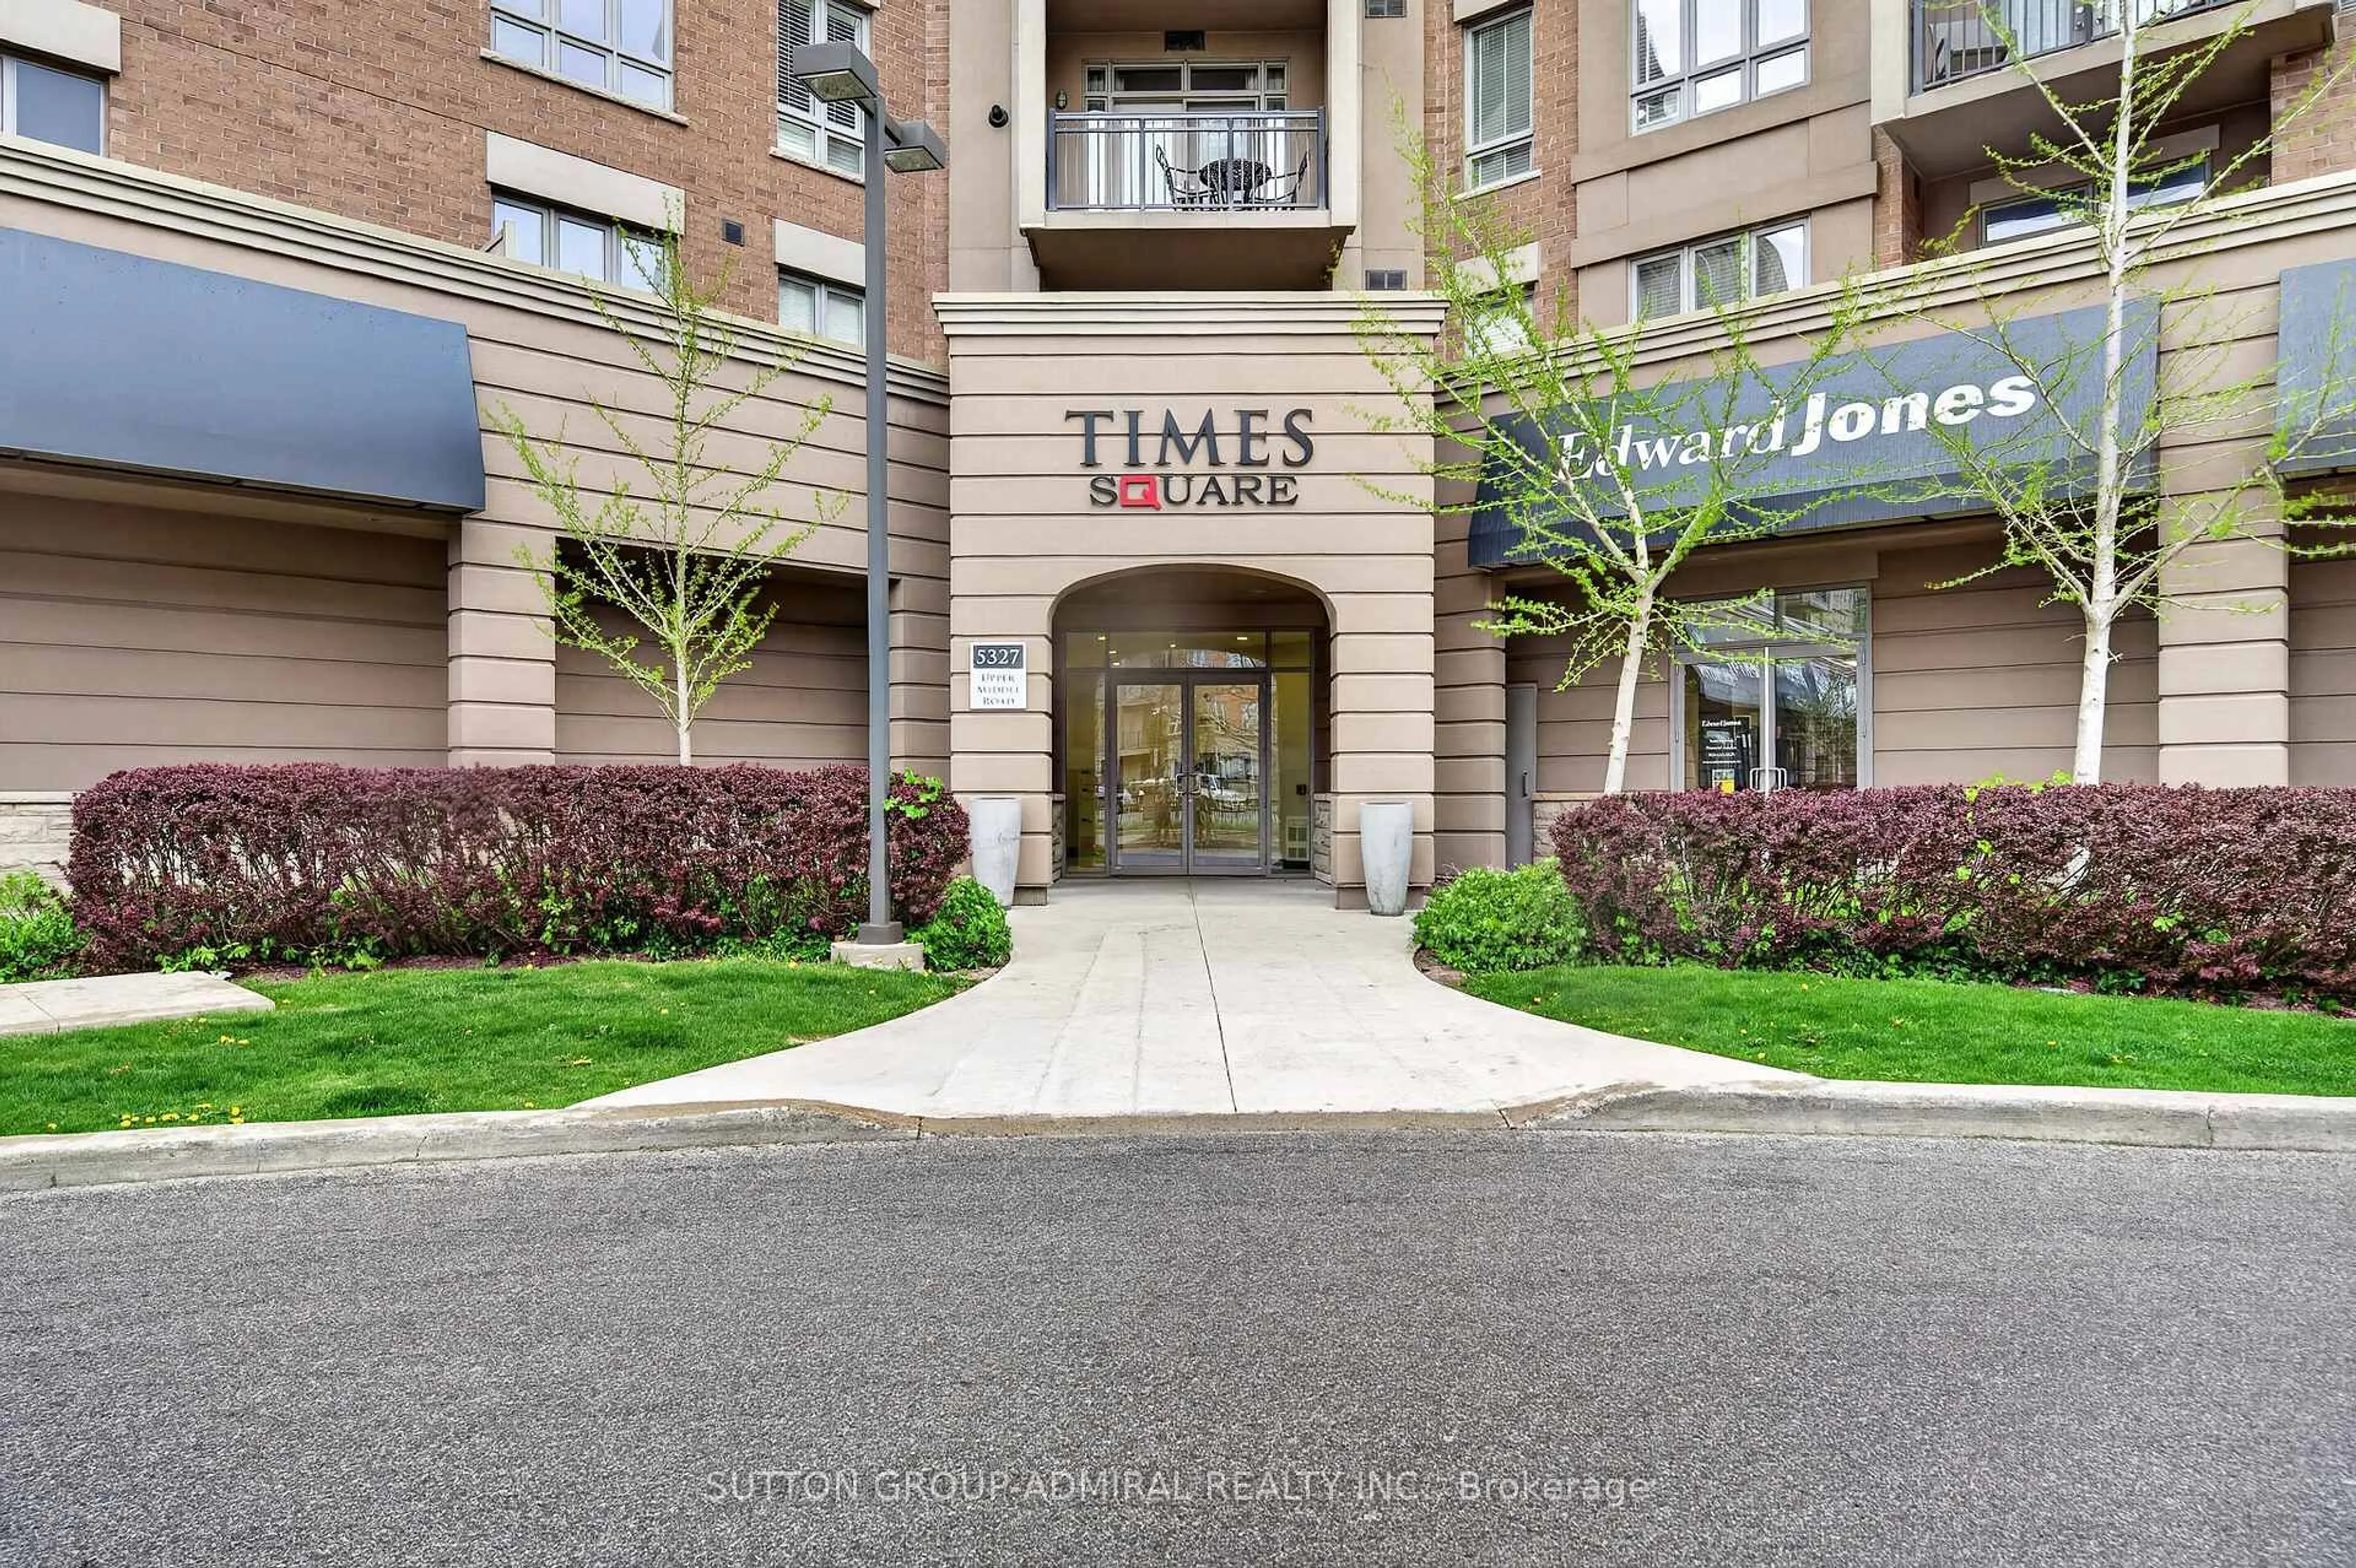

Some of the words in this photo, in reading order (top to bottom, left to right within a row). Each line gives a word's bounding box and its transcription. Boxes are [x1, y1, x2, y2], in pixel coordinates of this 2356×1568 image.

[1064, 407, 1314, 467] TIMES
[1555, 398, 1788, 482] Edward
[1790, 375, 2038, 456] Jones
[1090, 474, 1299, 511] SQUARE
[976, 648, 1019, 665] 5327
